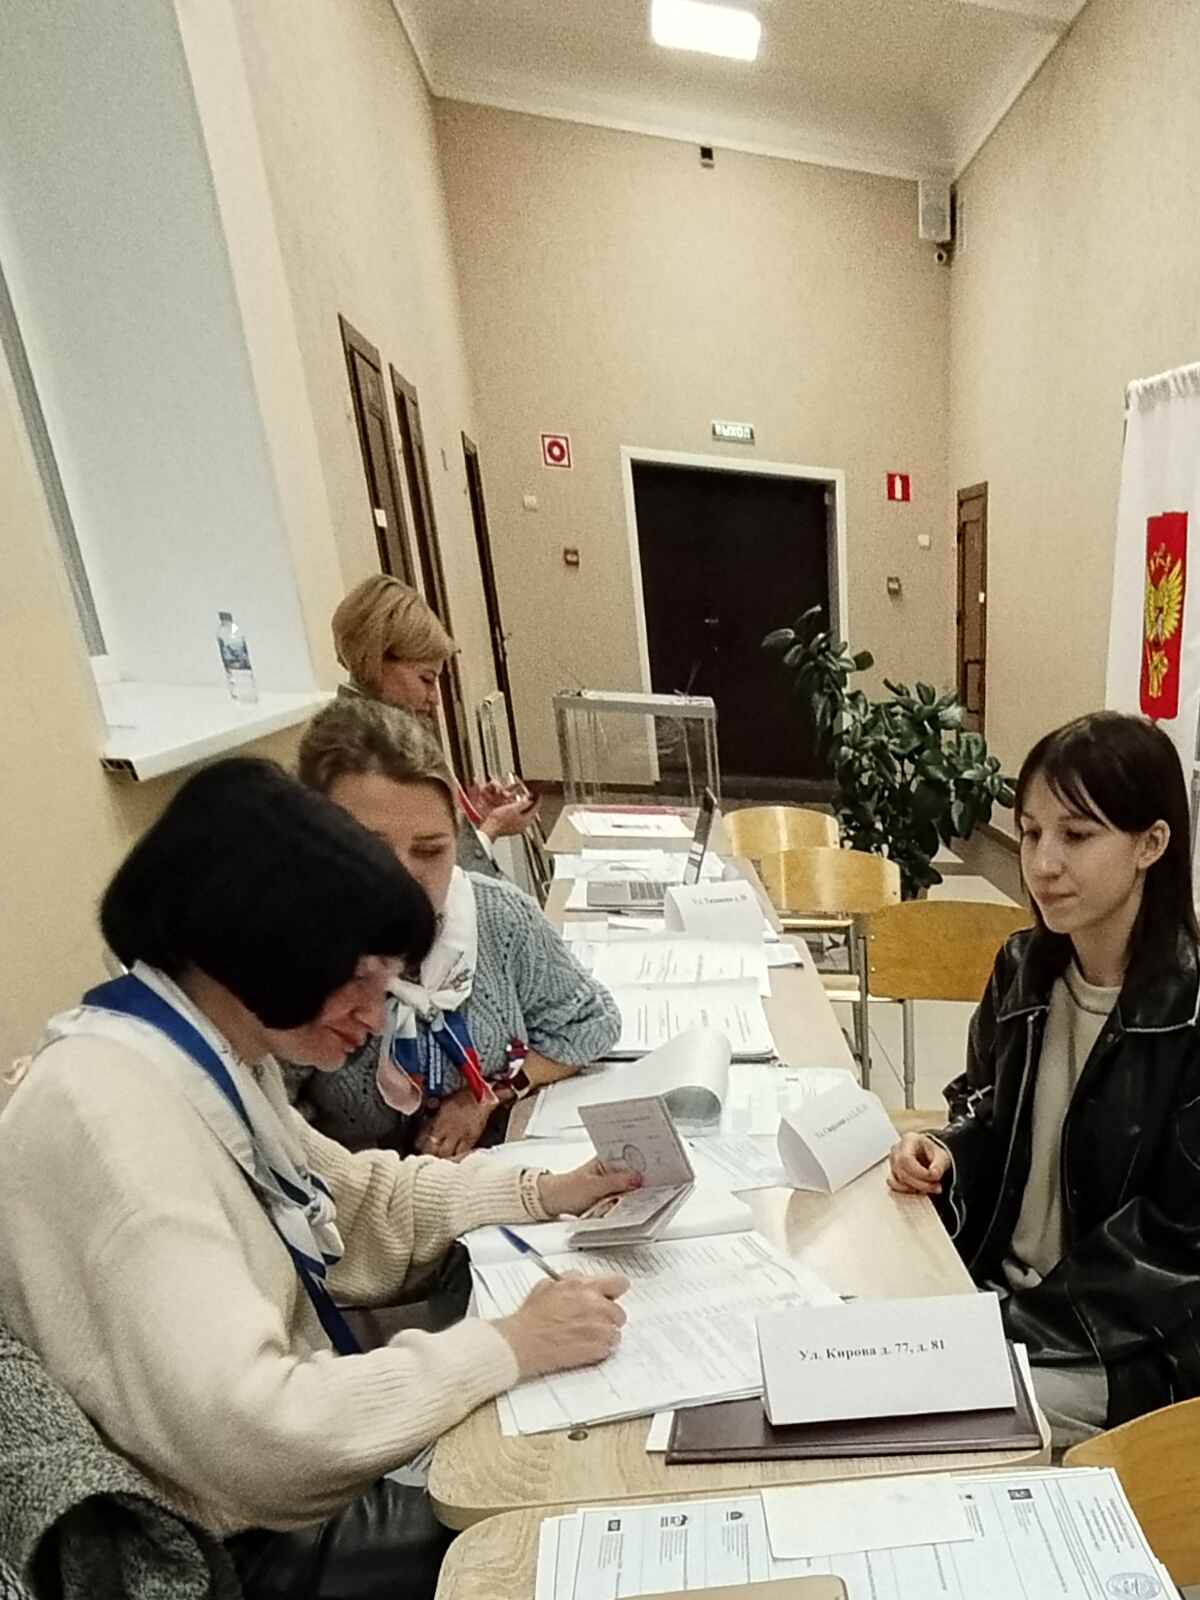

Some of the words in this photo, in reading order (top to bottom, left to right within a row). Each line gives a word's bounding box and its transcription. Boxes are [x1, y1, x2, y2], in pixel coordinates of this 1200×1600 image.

[799, 1349, 822, 1361] Ул.
[826, 1346, 877, 1360] Кирова
[894, 1342, 914, 1354] 77,
[930, 1339, 945, 1351] 81
